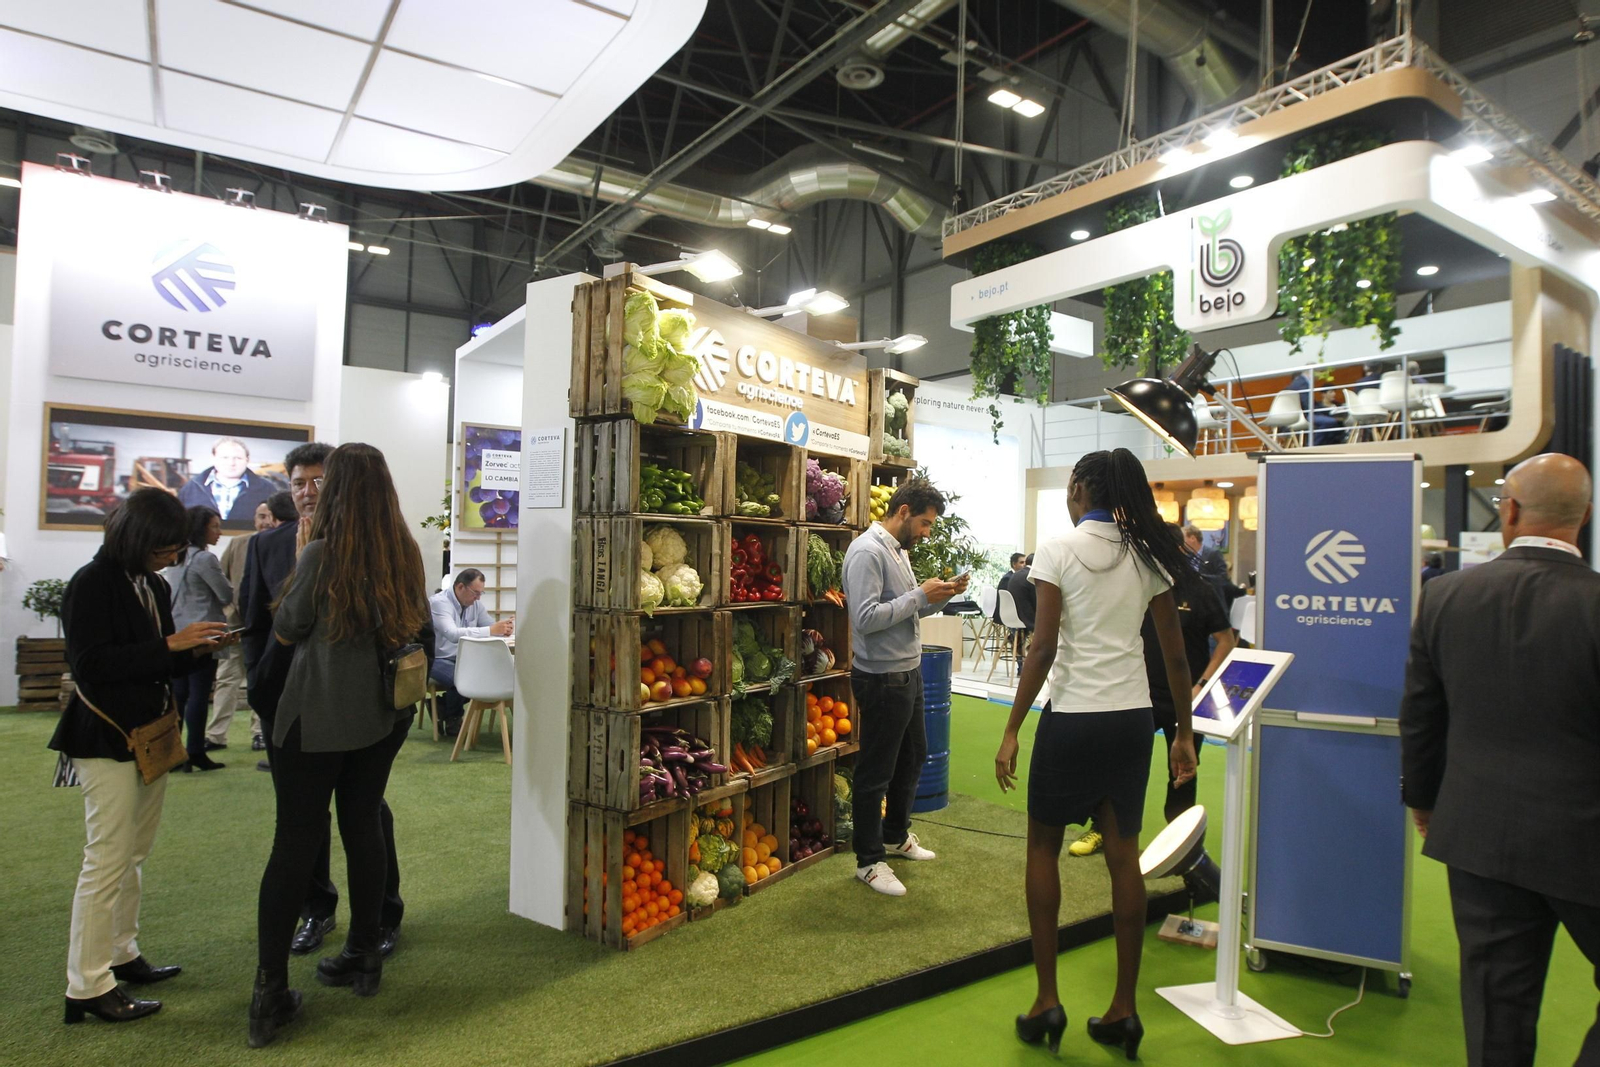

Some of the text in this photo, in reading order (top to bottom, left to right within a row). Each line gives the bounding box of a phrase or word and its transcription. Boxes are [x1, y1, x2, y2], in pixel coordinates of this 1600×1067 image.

[979, 281, 1008, 299] bejo.pt
[1200, 288, 1245, 313] bejo
[102, 320, 272, 358] CORTEVA
[134, 353, 243, 374] agriscience
[737, 381, 804, 410] agriscience
[942, 401, 965, 410] nature
[966, 405, 984, 413] never
[596, 562, 606, 593] LANGA
[1296, 614, 1372, 626] agriscience
